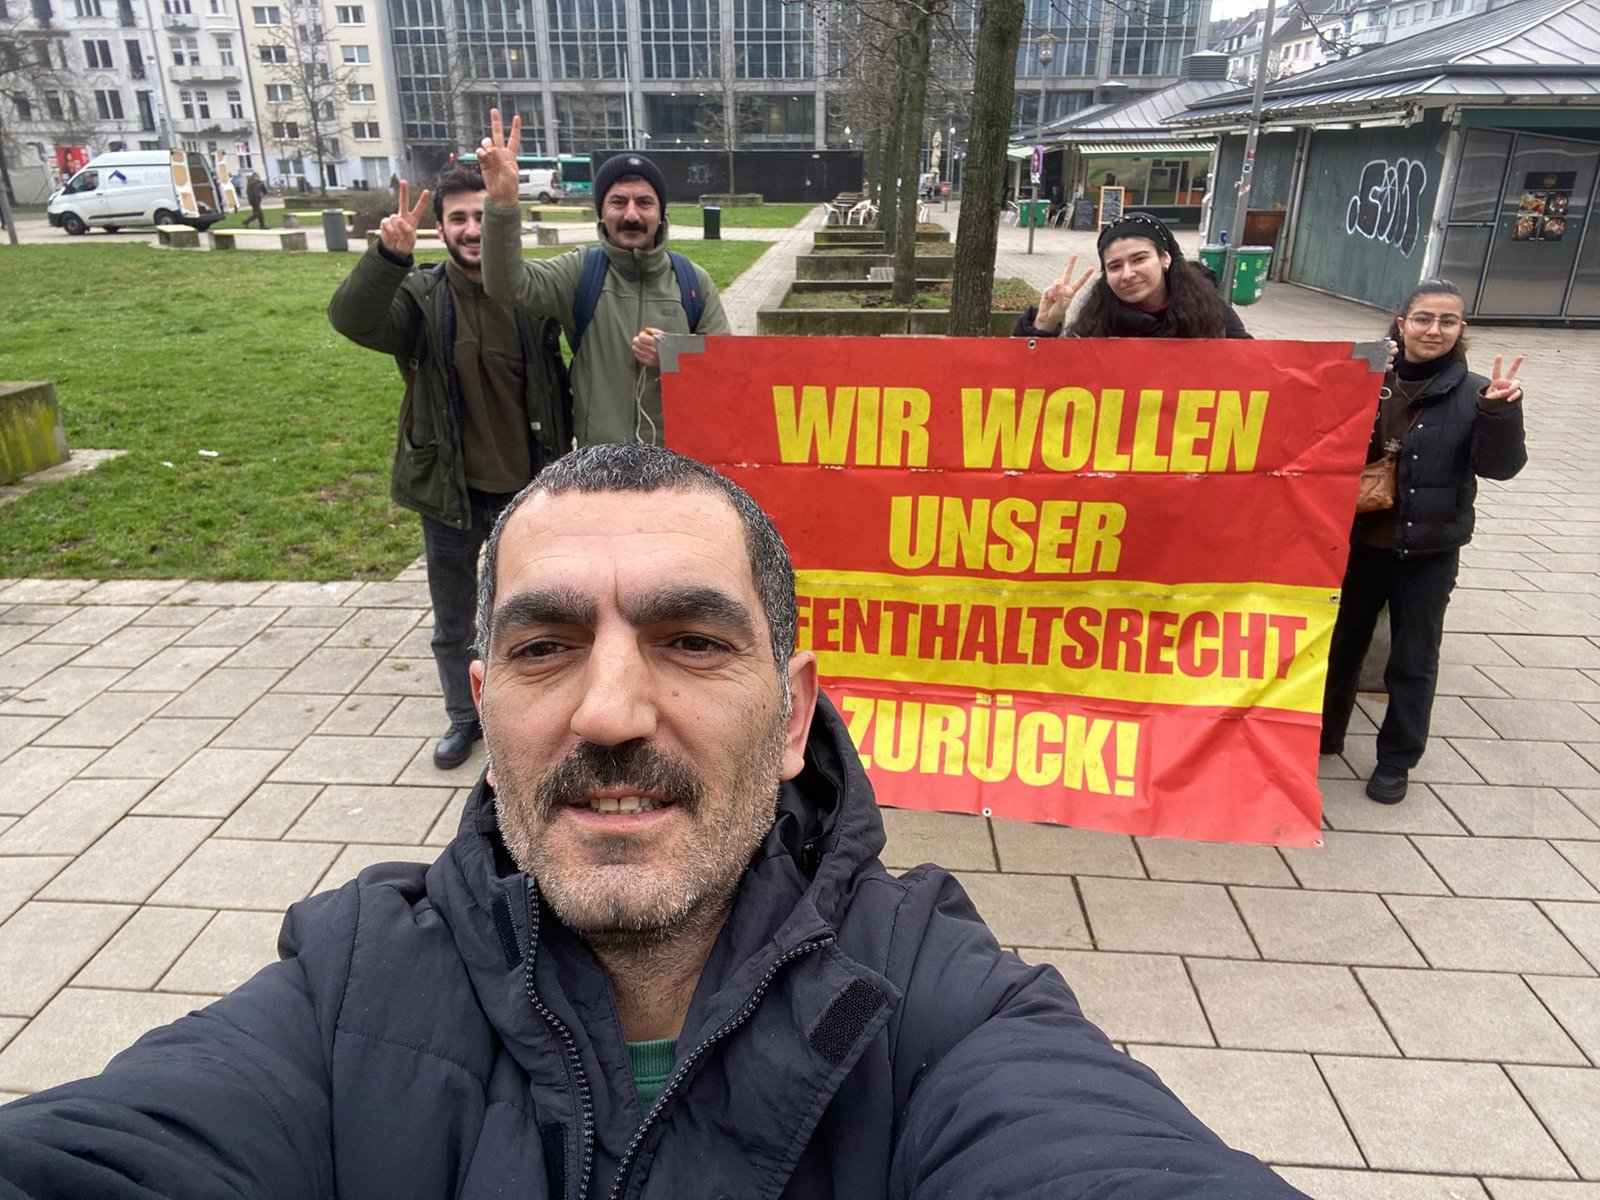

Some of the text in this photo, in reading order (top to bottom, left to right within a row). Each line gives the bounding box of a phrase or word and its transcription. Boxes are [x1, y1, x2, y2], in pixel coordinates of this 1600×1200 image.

[772, 385, 1270, 472] WIR WOLLEN
[889, 495, 1127, 574] UNSER
[842, 692, 1140, 797] ZURÜCK!
